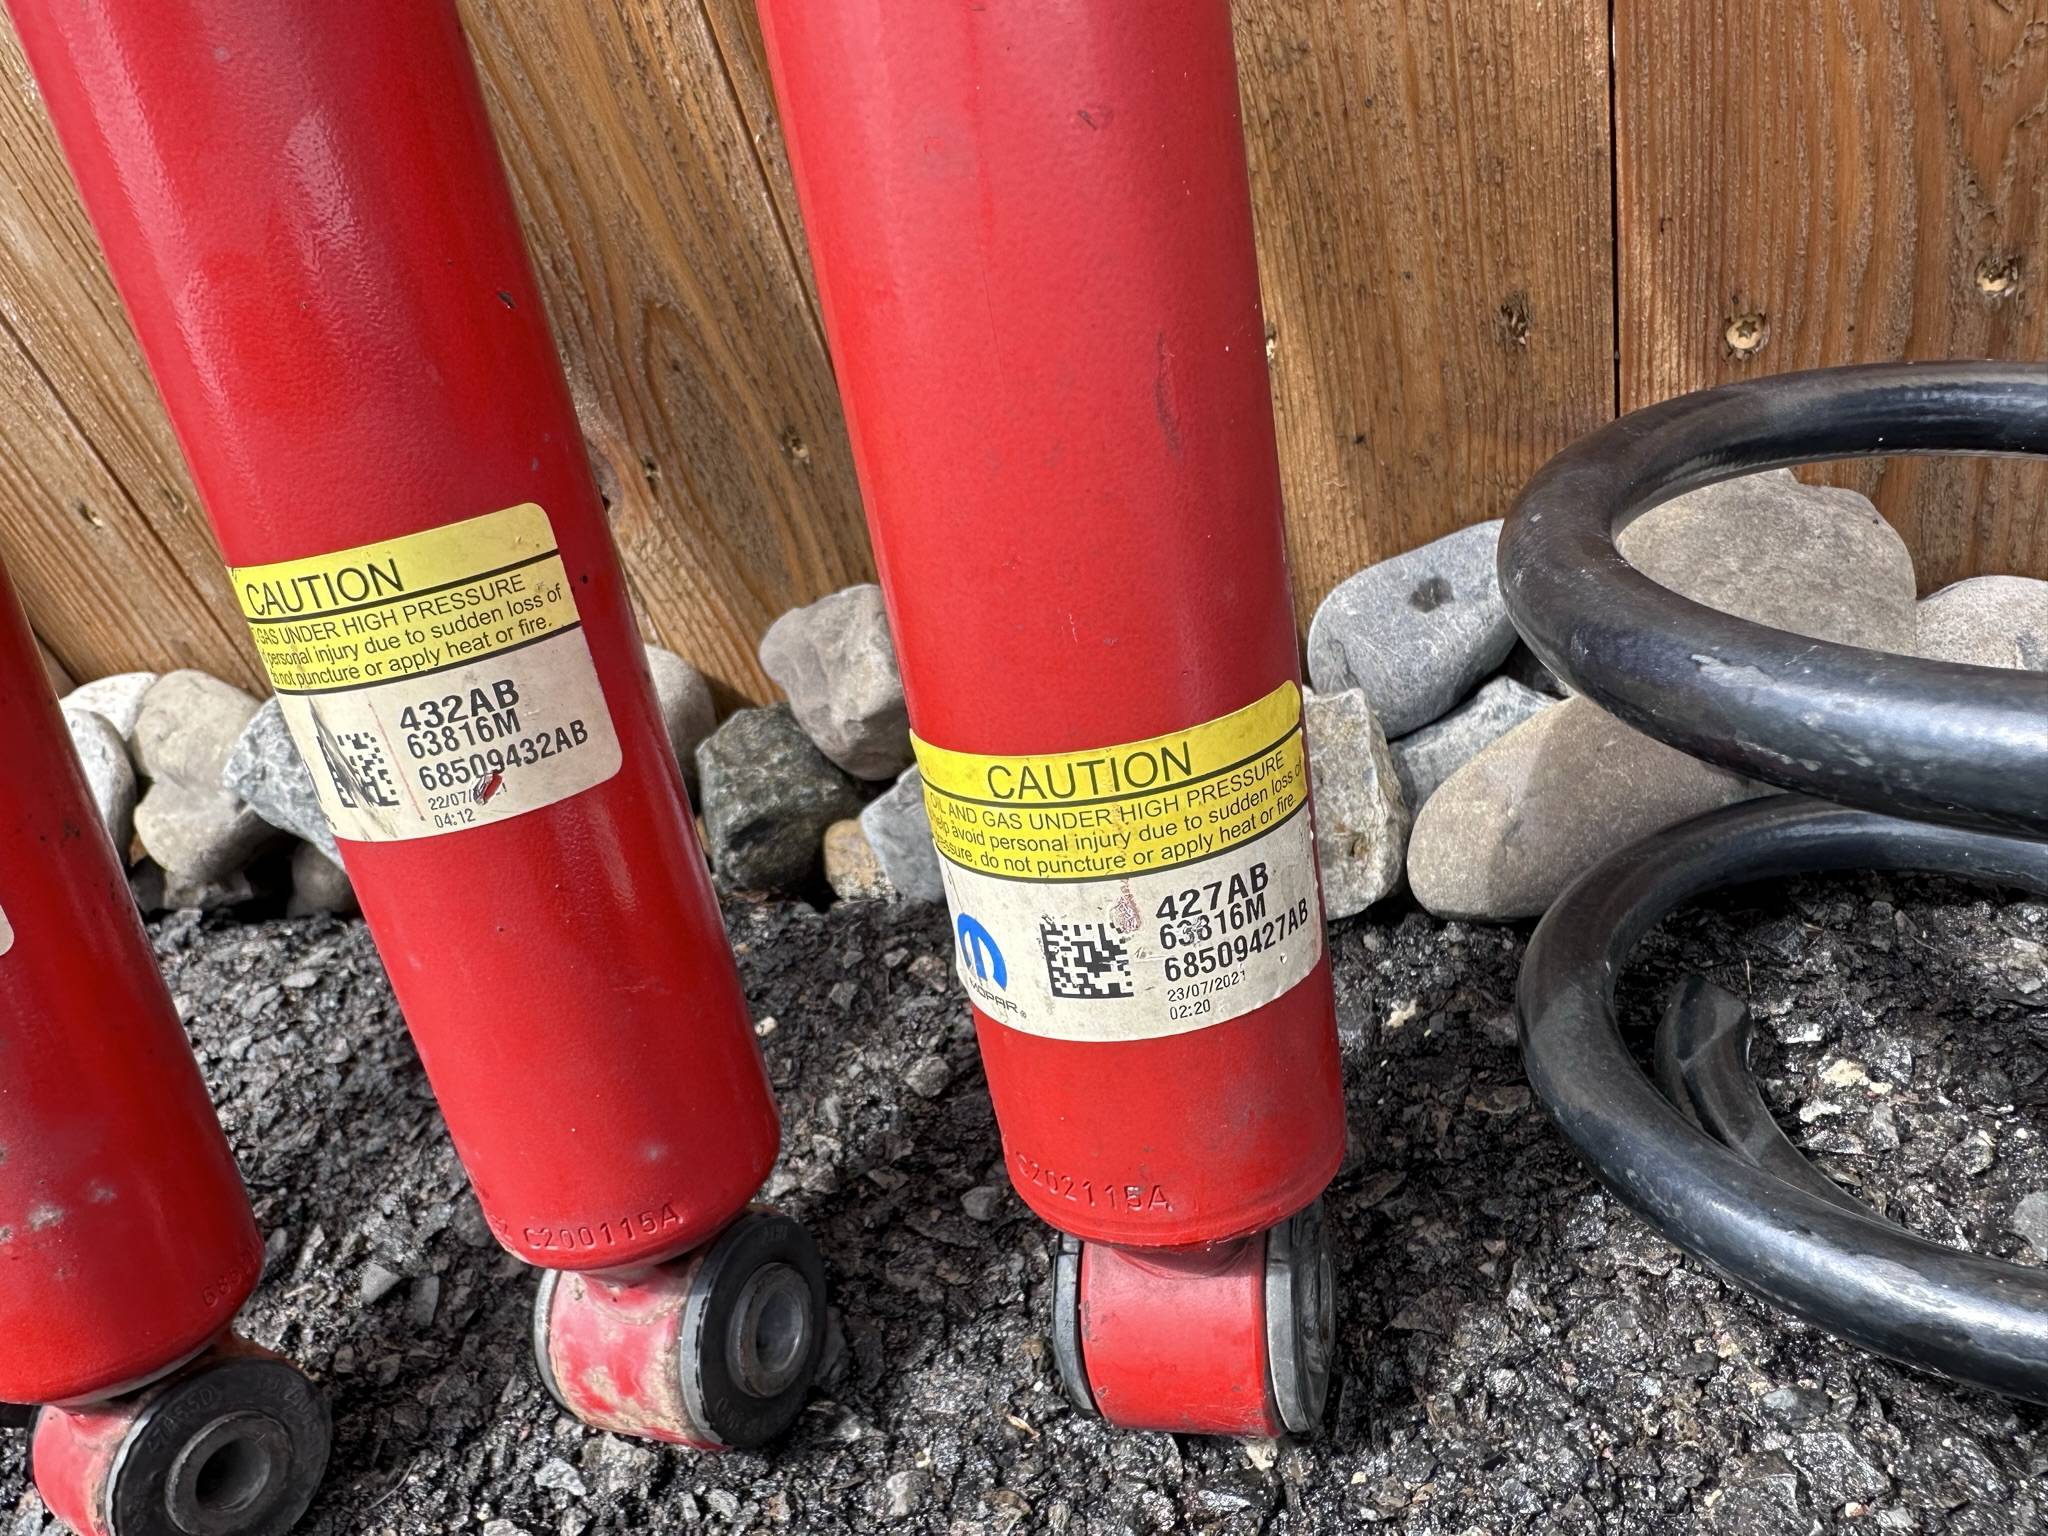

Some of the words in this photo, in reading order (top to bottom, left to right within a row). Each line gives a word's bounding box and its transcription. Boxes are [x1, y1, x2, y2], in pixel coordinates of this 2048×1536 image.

[245, 558, 404, 616] CAUTION
[256, 627, 279, 645] GAS
[278, 621, 341, 645] UNDER
[342, 608, 399, 636] HIGH
[402, 573, 526, 623] PRESSURE
[267, 647, 313, 669] personal
[313, 643, 359, 665] injury
[364, 636, 401, 654] due
[405, 628, 425, 645] to
[430, 607, 504, 639] sudden
[507, 596, 544, 617] loss
[547, 582, 562, 603] of
[279, 671, 297, 686] not
[295, 666, 361, 689] puncture
[364, 661, 383, 677] or
[388, 647, 441, 673] apply
[445, 632, 493, 658] heat
[495, 627, 514, 644] or
[518, 615, 553, 637] fire.
[400, 678, 520, 732] 432AB
[407, 708, 522, 760] 63816M
[418, 718, 589, 791] 68509432AB
[987, 740, 1192, 800] CAUTION
[434, 808, 476, 829] 04:12
[949, 801, 977, 824] AND
[982, 810, 1023, 830] GAS
[1029, 808, 1113, 830] UNDER
[1120, 794, 1179, 822] HIGH
[1186, 750, 1285, 808] PRESSURE
[951, 825, 985, 846] avoid
[989, 834, 1068, 852] personal
[1074, 831, 1131, 854] injury
[1138, 822, 1178, 842] due
[1184, 815, 1202, 831] to
[1208, 787, 1268, 824] sudden
[1271, 771, 1293, 796] loss
[980, 851, 999, 869] do
[1004, 856, 1033, 873] not
[1037, 855, 1127, 877] puncture
[1133, 850, 1154, 865] or
[1161, 833, 1214, 861] apply
[1219, 813, 1257, 843] heat
[1260, 806, 1274, 825] or
[1155, 862, 1269, 922] 427AB
[1159, 892, 1266, 950] 63816M
[1164, 897, 1308, 982] 68509427AB
[1167, 970, 1246, 1002] 23/07/2021
[1169, 999, 1211, 1020] 02:20
[523, 1202, 684, 1249] C200115A
